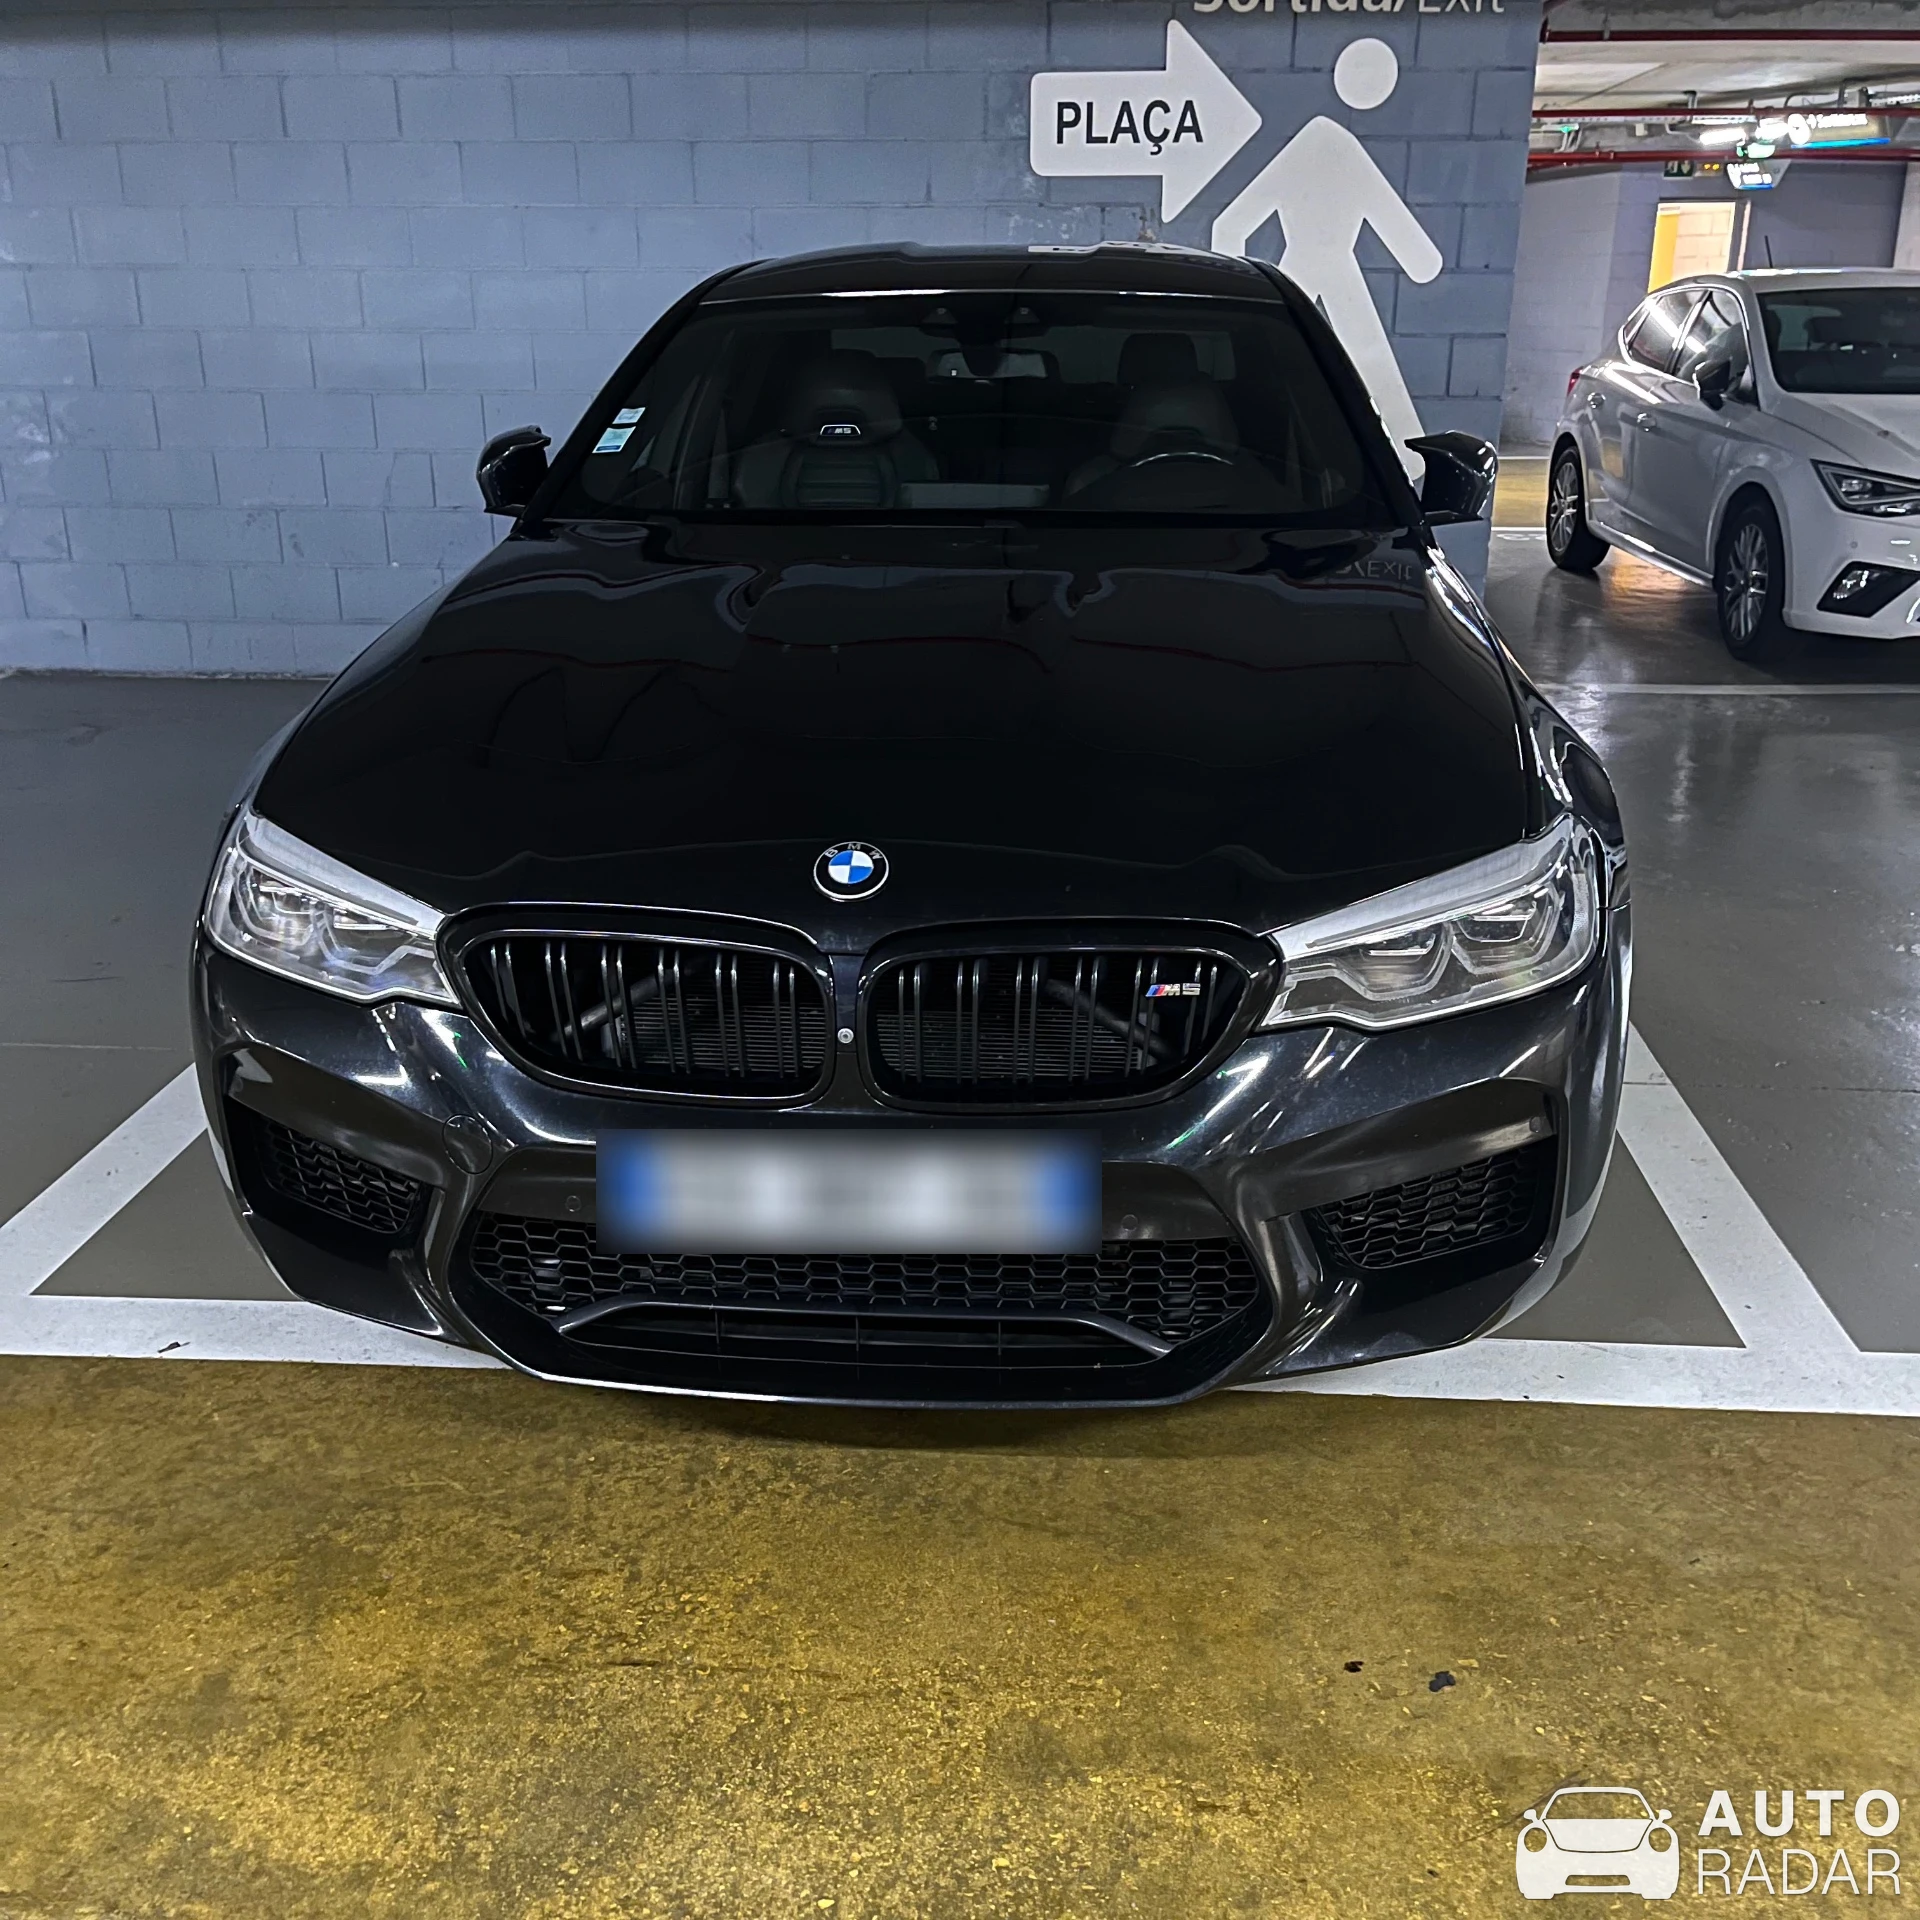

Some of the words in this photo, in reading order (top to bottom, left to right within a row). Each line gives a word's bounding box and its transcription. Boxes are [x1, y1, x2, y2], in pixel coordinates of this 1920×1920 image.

[1056, 99, 1204, 156] PLAÇA
[824, 843, 884, 860] BMW
[1162, 982, 1201, 996] M5
